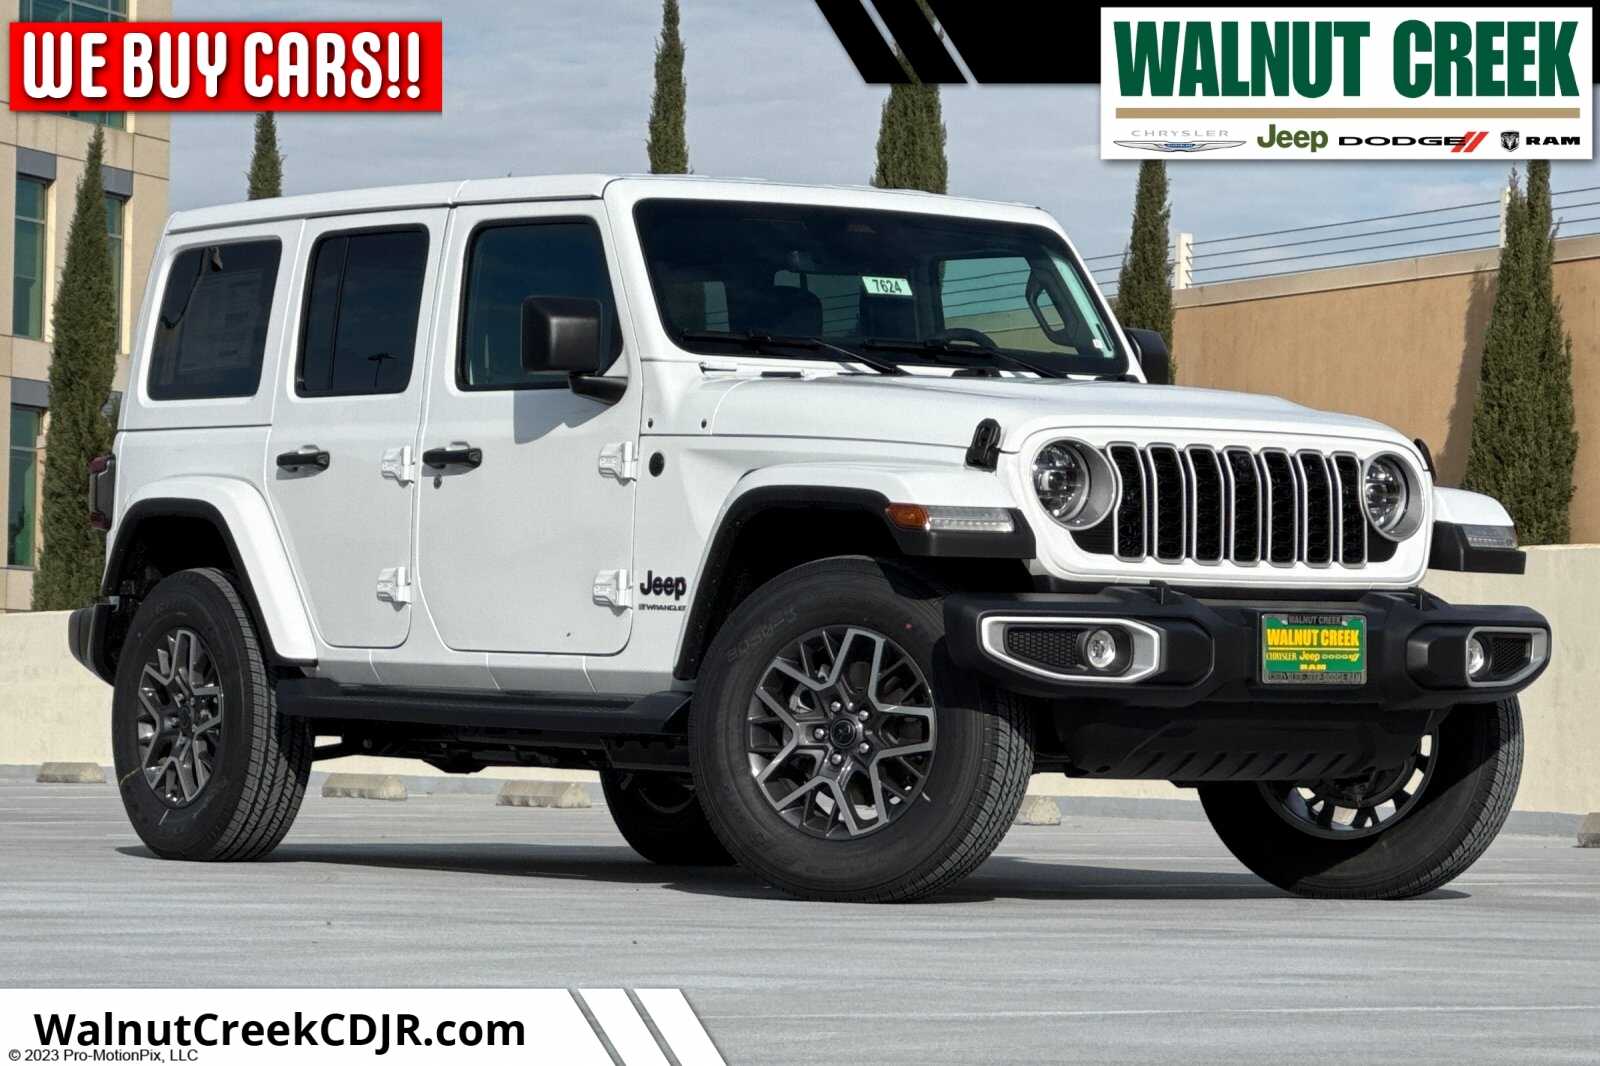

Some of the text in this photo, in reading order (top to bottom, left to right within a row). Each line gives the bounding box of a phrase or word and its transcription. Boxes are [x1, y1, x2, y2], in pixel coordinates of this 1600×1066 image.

[872, 279, 903, 293] 7624
[640, 570, 687, 601] Jeep
[1267, 628, 1359, 647] WALNUT CREEK
